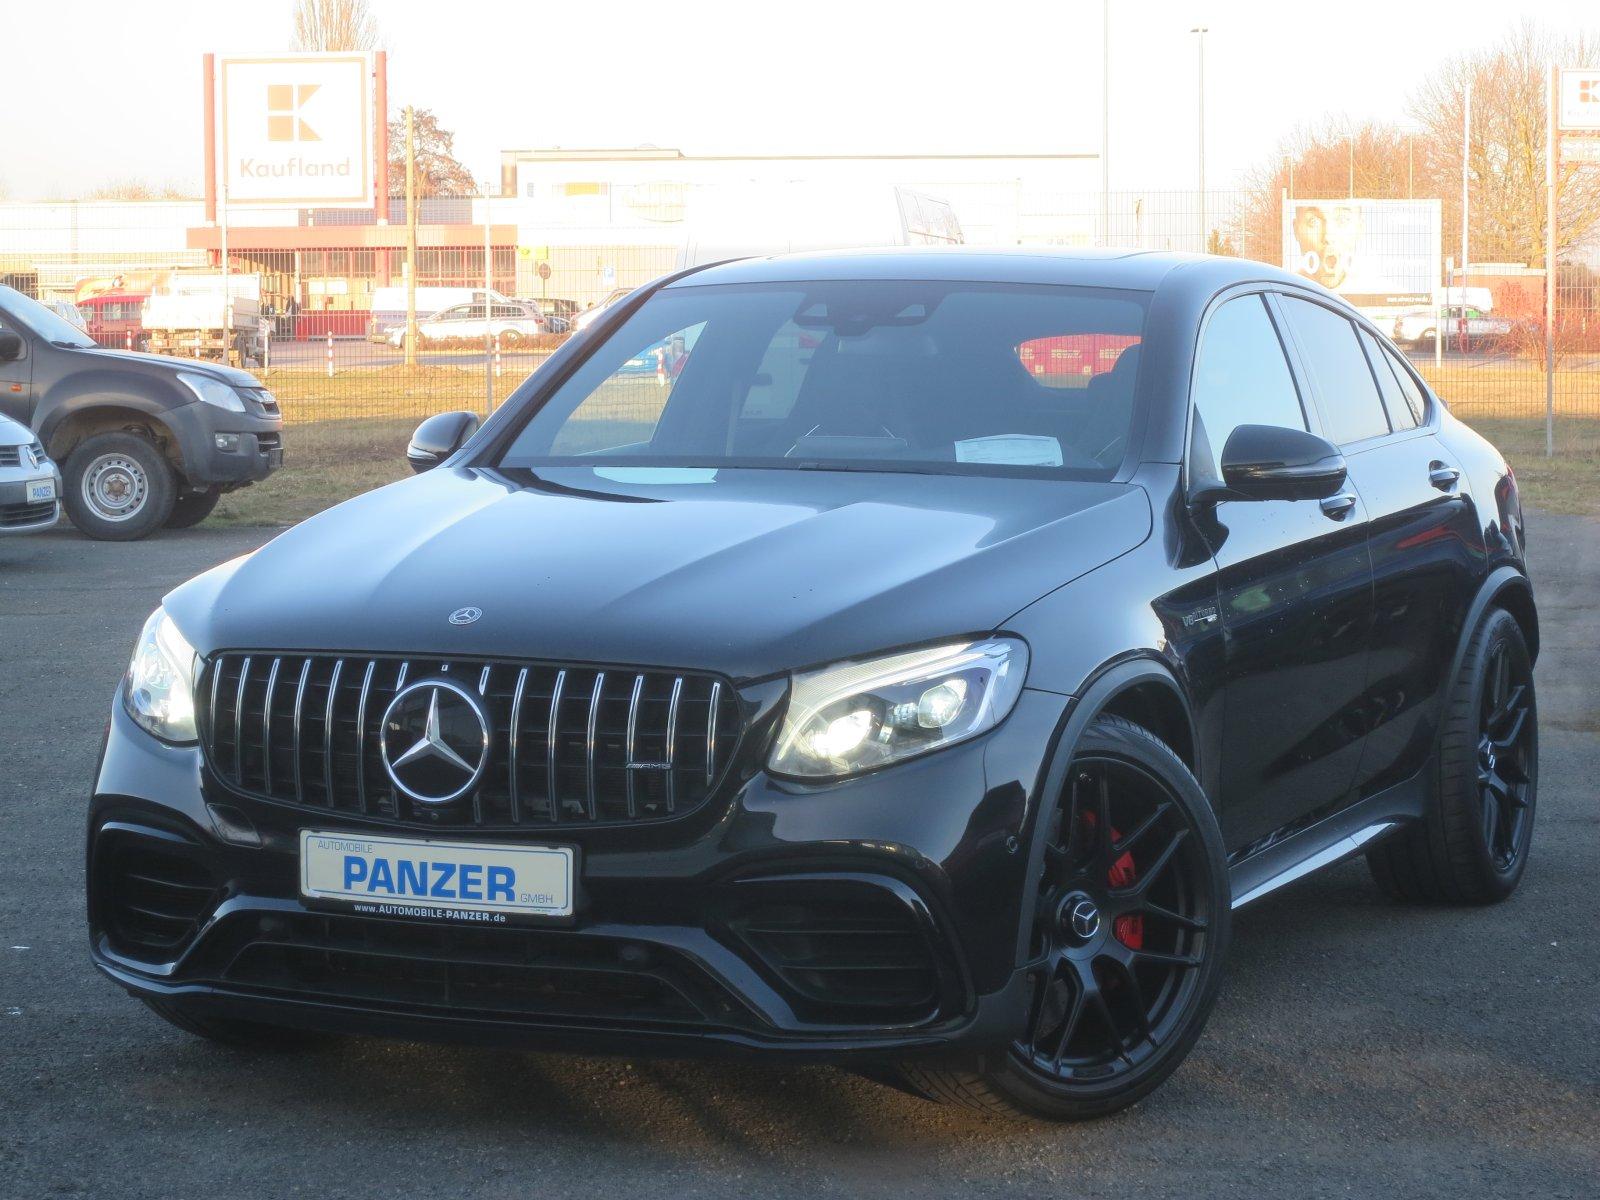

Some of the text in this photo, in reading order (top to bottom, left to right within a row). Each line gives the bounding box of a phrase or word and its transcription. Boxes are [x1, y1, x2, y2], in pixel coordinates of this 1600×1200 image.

[240, 157, 350, 177] Kaufland
[318, 840, 373, 853] AUTOMOBILE
[344, 855, 515, 902] PANZER
[521, 893, 553, 904] GMBH
[354, 904, 506, 922] www.AUTOMOBILE-PANZER.de
